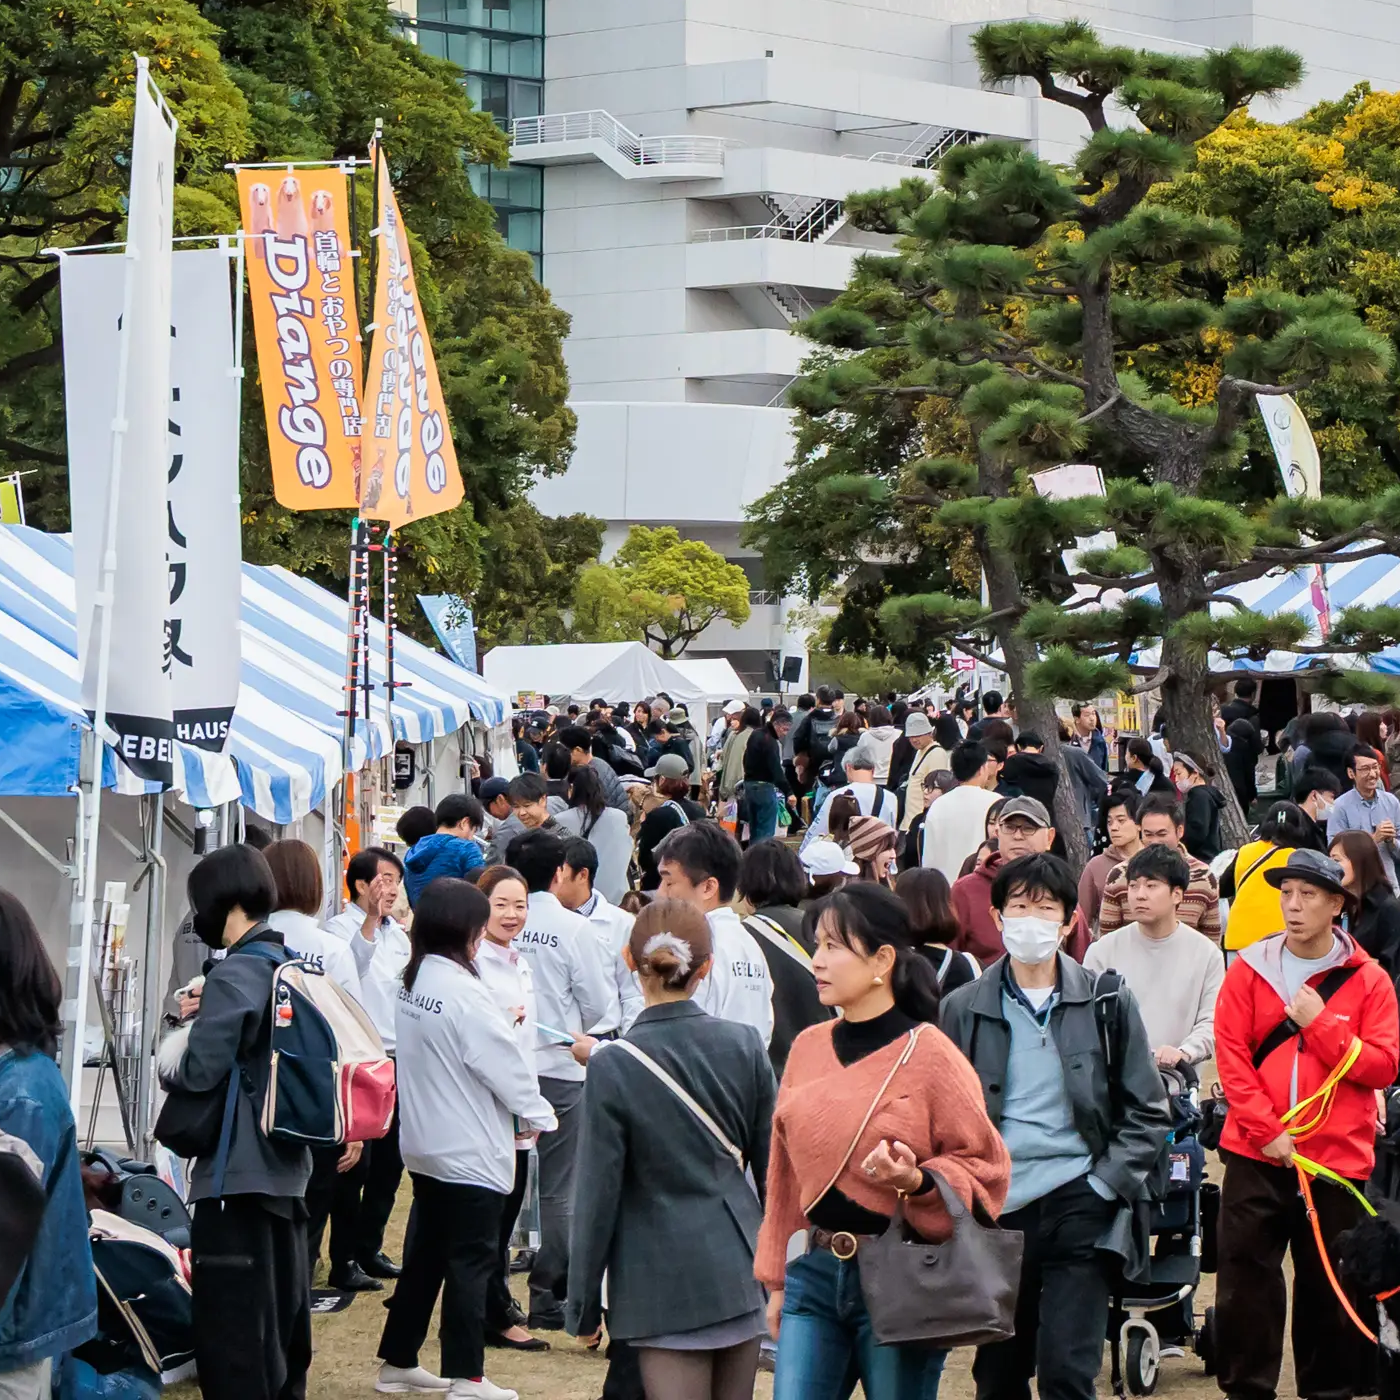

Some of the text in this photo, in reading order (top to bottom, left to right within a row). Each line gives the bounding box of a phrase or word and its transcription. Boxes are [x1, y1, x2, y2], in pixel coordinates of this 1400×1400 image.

[262, 229, 332, 490] Diange
[176, 721, 229, 740] HAUS
[523, 930, 558, 948] HAUS
